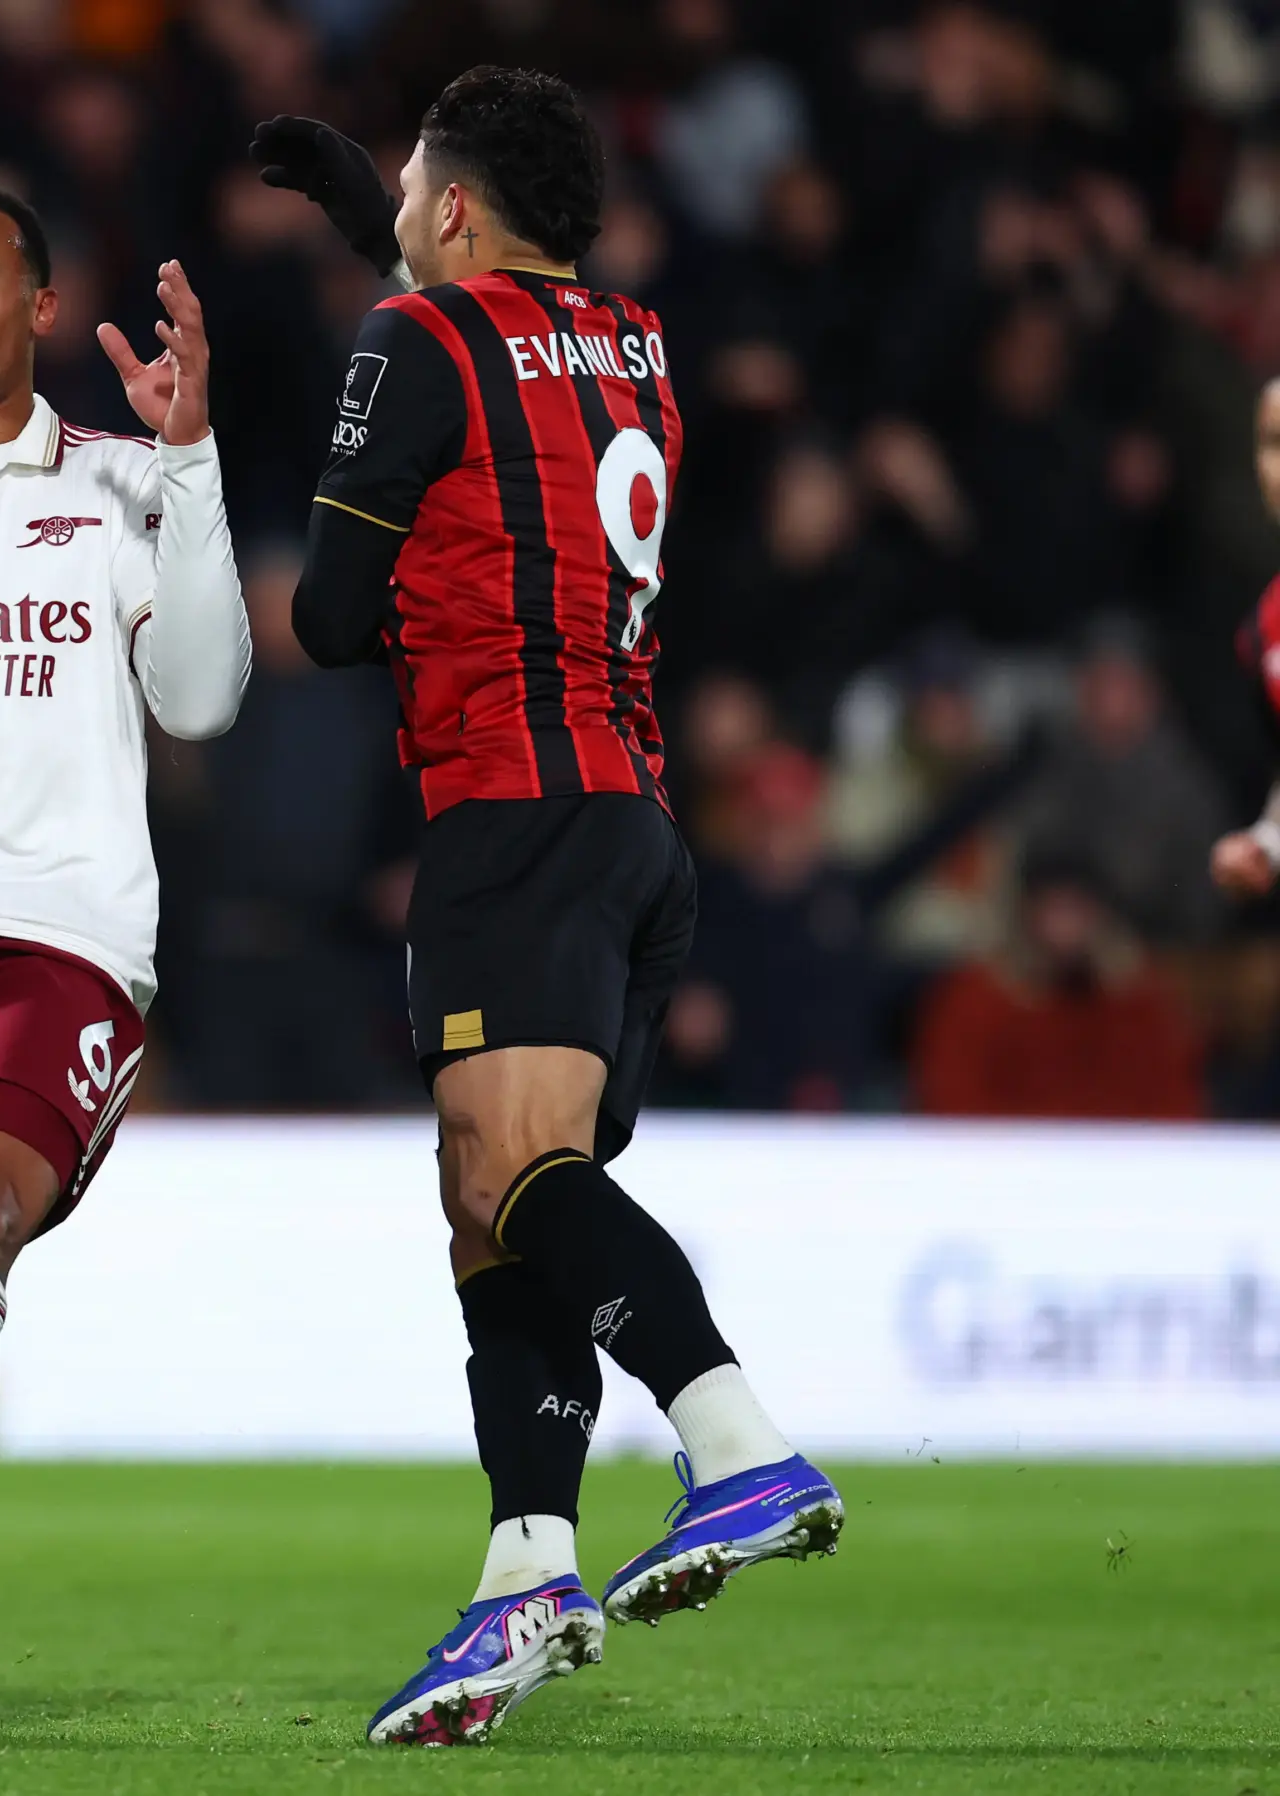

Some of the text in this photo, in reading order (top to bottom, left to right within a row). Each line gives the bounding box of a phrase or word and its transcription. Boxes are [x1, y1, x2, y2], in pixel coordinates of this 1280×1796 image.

[564, 290, 587, 309] AFCB
[145, 513, 163, 531] R
[594, 427, 667, 652] 9
[79, 1019, 116, 1092] 6
[604, 1310, 633, 1350] umbro
